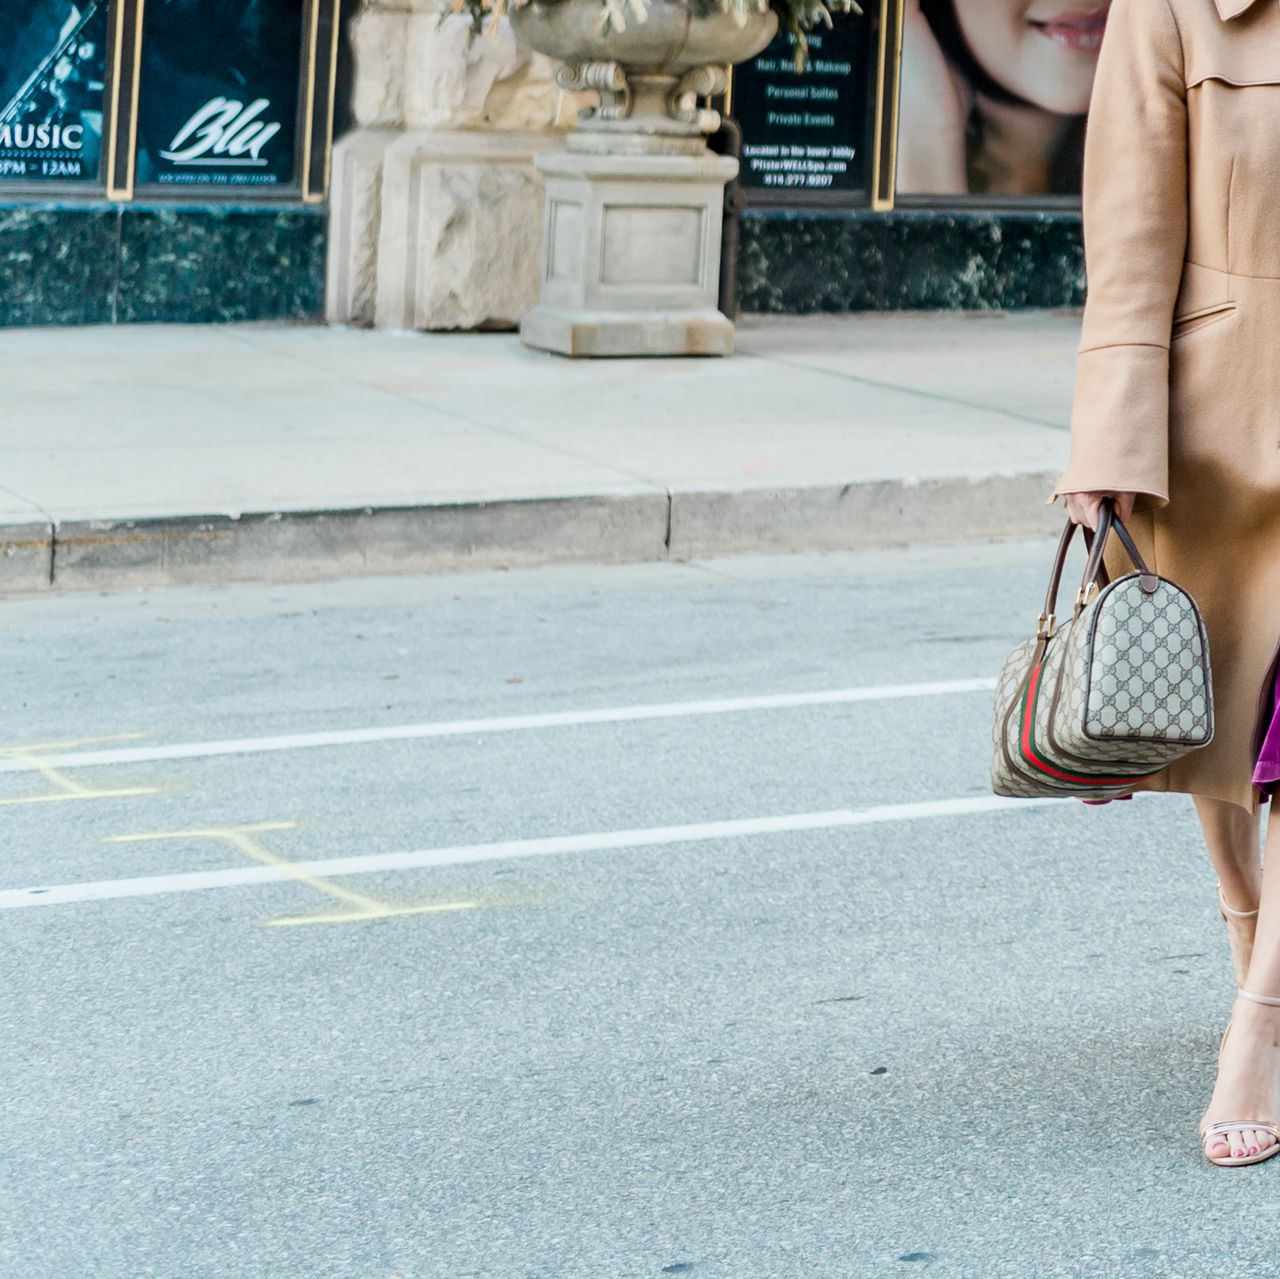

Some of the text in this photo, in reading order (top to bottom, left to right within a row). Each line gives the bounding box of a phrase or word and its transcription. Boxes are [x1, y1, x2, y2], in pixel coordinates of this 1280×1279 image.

[767, 85, 809, 99] Personal
[768, 112, 802, 126] Private
[159, 96, 281, 161] Blu
[0, 159, 27, 176] PM
[42, 160, 81, 176] 12AM
